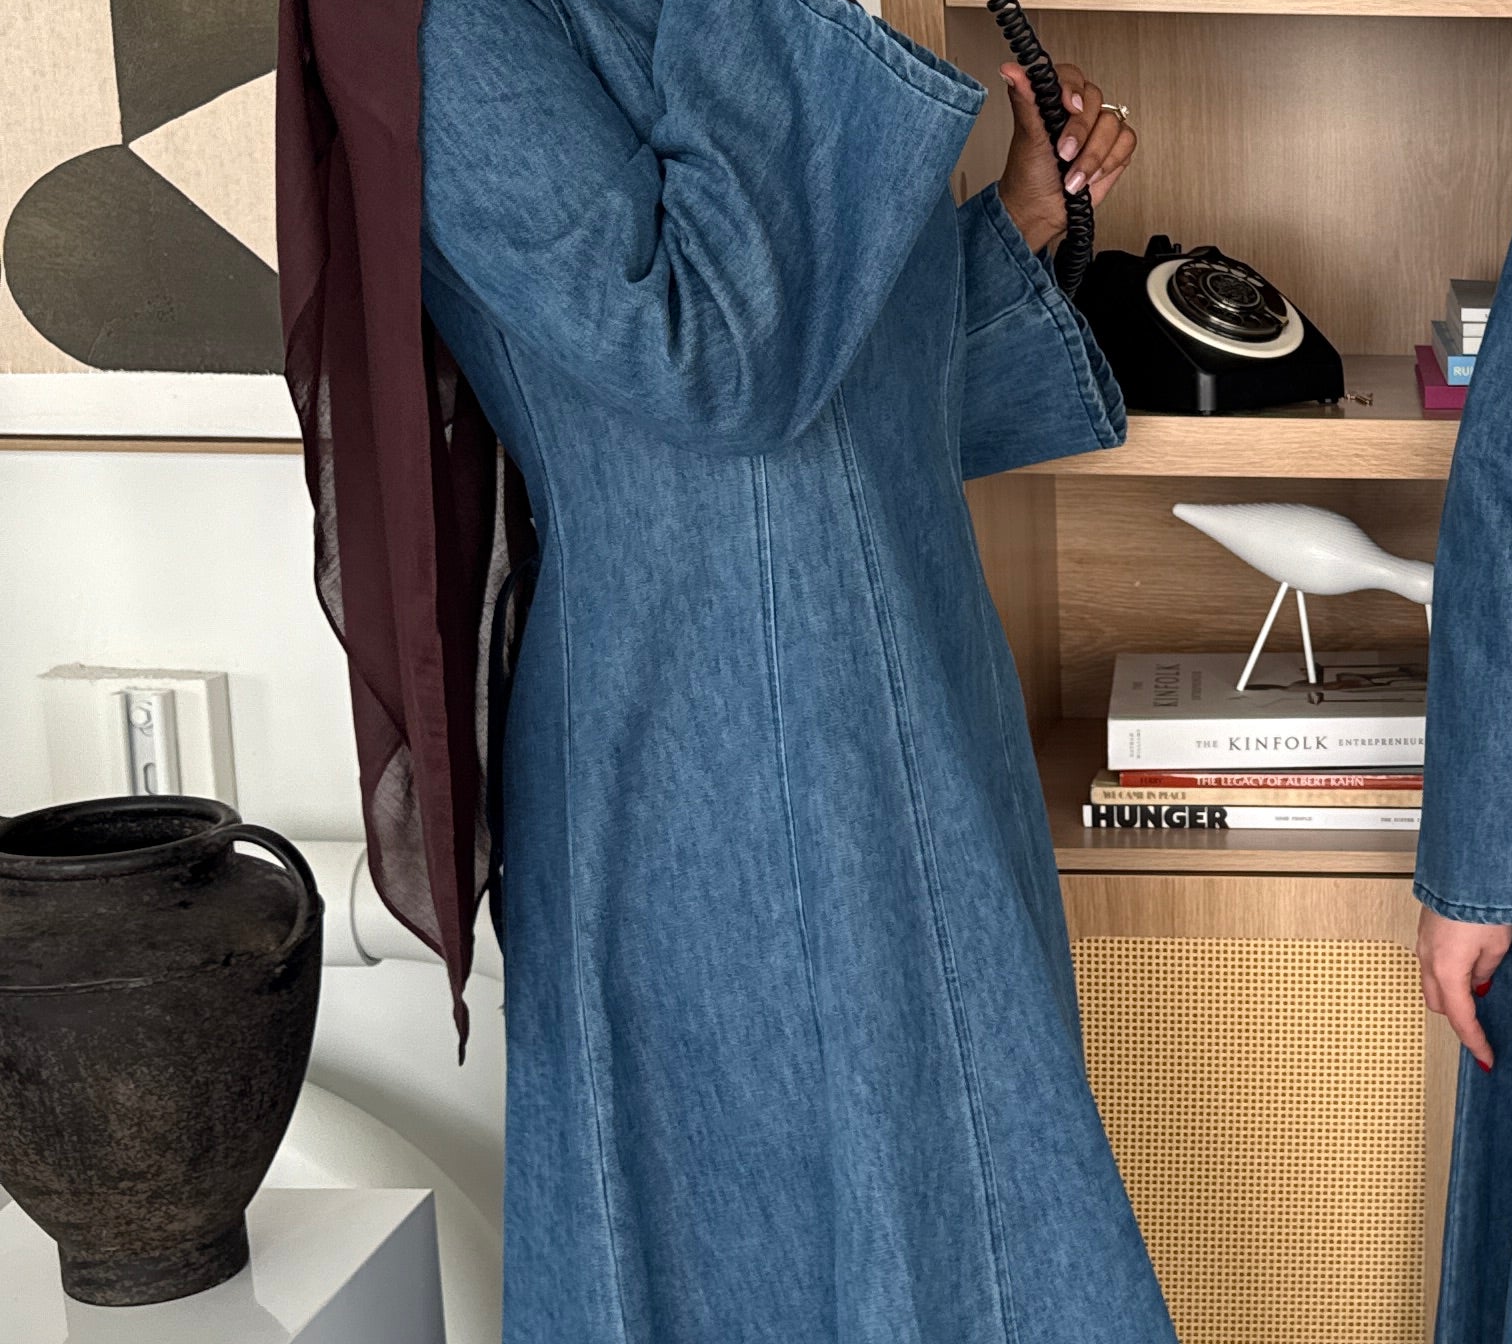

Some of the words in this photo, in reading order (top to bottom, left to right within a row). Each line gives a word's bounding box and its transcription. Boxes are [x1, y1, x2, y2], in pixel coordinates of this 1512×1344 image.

[1153, 663, 1181, 707] KINFOLK
[1195, 740, 1218, 748] THE
[1229, 736, 1328, 751] KINFOLK
[1338, 738, 1424, 747] ENTREPRENEUR
[1196, 777, 1218, 786] THE
[1221, 776, 1264, 787] LEGACY
[1267, 776, 1282, 787] OF
[1286, 776, 1327, 787] ALBERT
[1330, 777, 1365, 787] KAHN
[1102, 790, 1117, 800] WE
[1118, 790, 1144, 800] CAME
[1146, 791, 1157, 800] IN
[1158, 791, 1186, 800] PEACE
[1091, 805, 1230, 829] HUNGER
